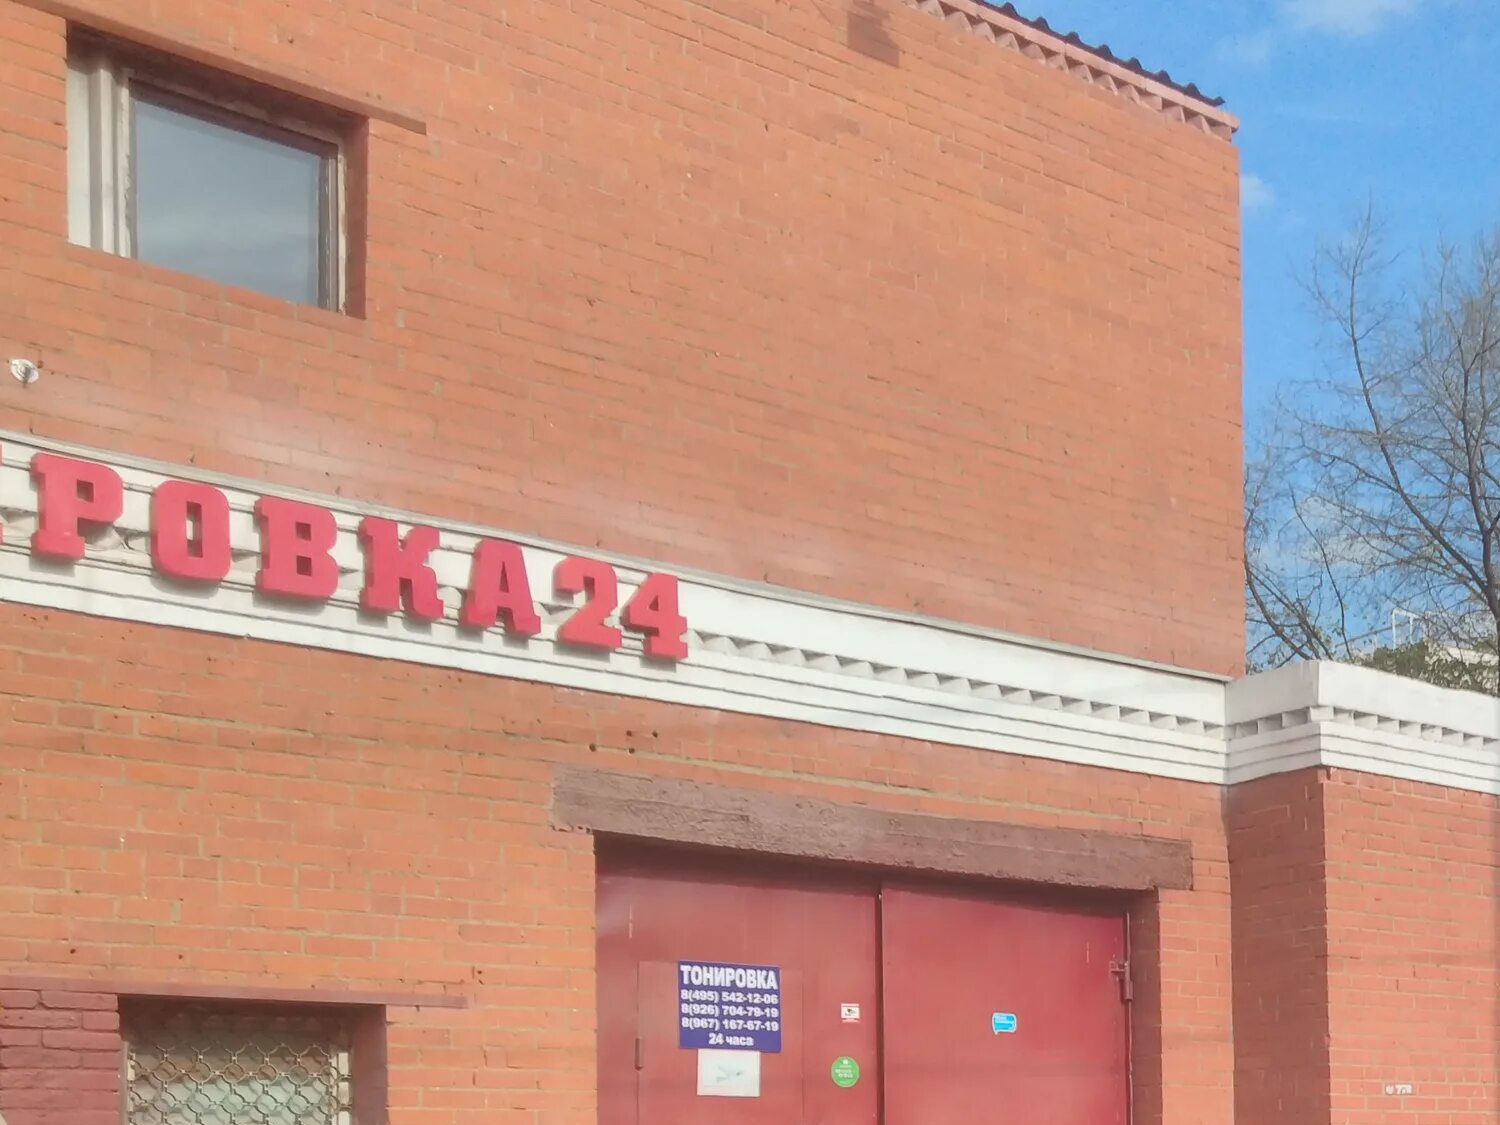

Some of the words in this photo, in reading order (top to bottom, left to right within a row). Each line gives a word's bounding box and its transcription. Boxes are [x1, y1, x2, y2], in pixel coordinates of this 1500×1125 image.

[0, 440, 688, 660] РОВКА24
[680, 964, 778, 989] ТОНИРОВКА
[681, 989, 719, 1003] 8(495)
[708, 1032, 724, 1044] 24
[725, 1035, 754, 1046] часа
